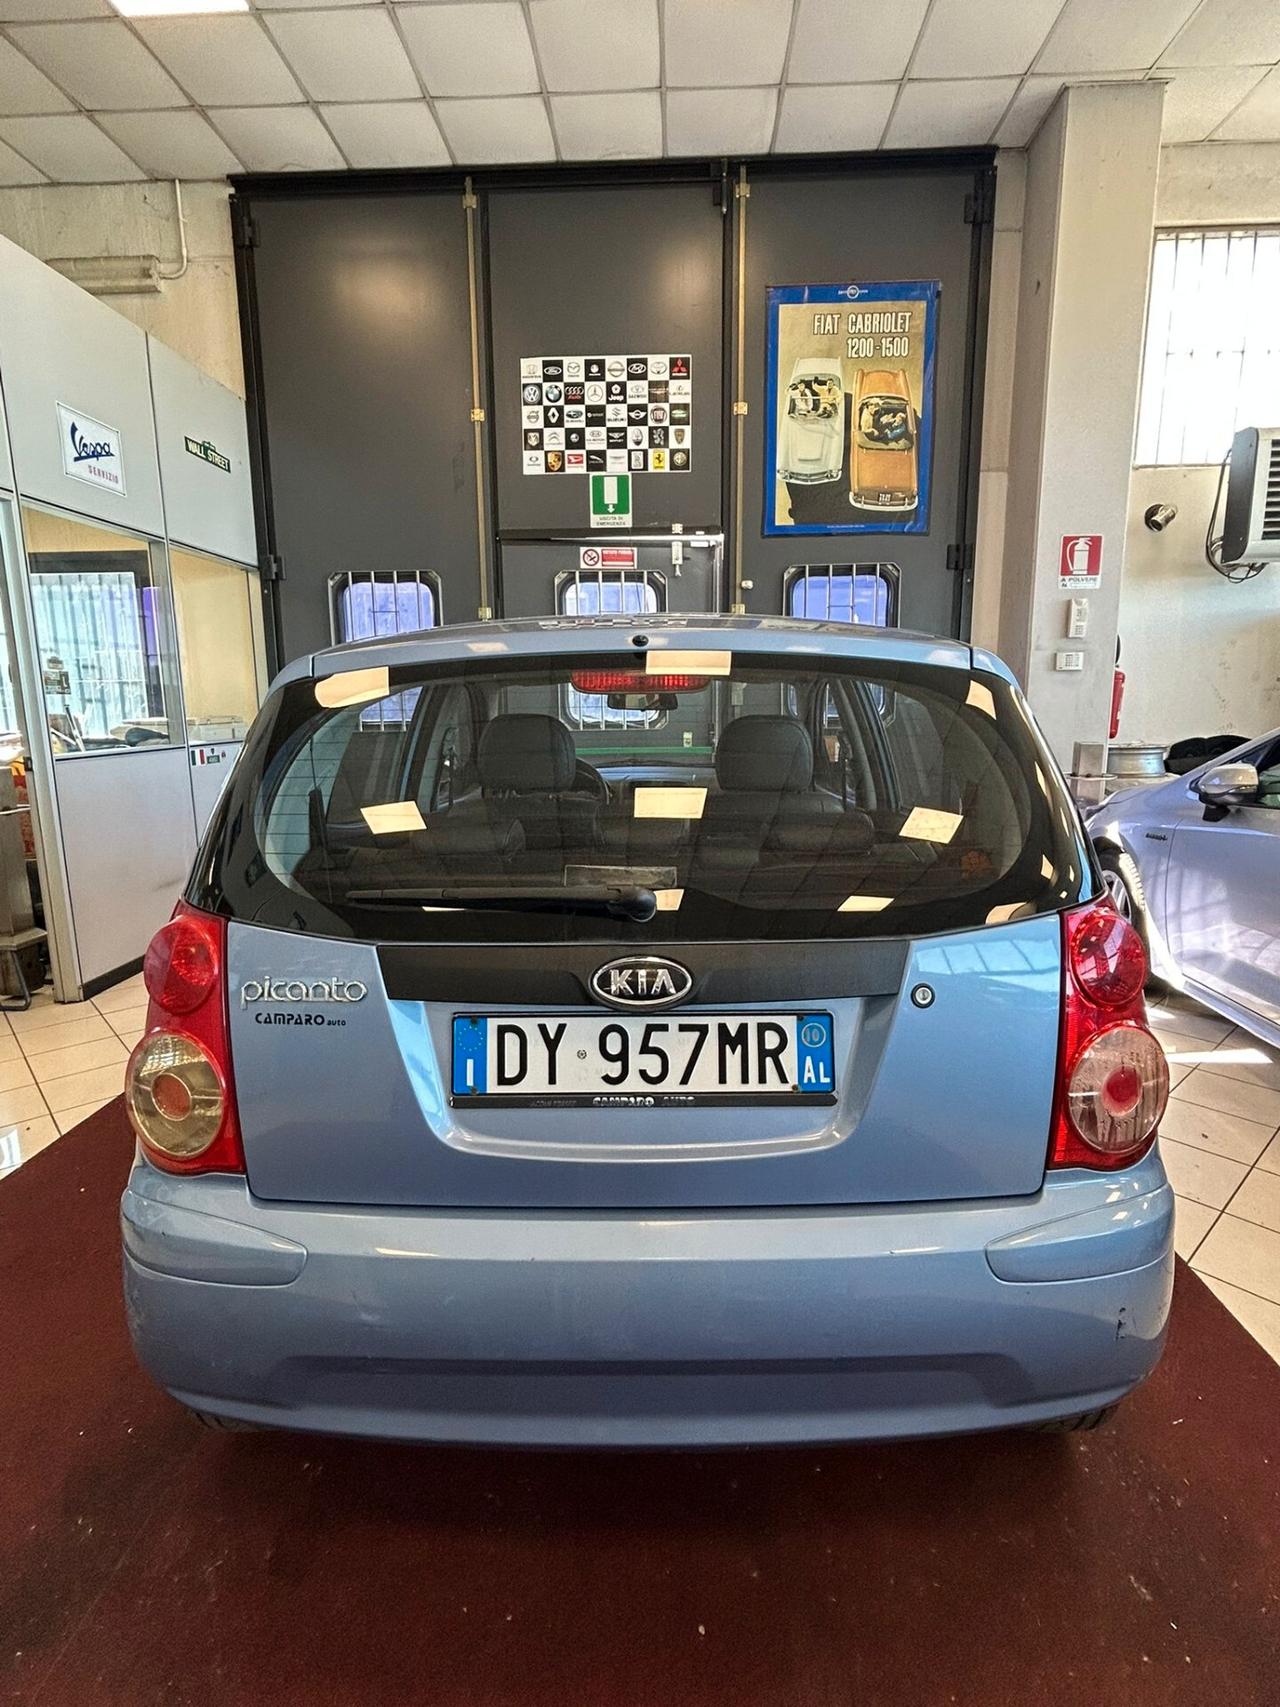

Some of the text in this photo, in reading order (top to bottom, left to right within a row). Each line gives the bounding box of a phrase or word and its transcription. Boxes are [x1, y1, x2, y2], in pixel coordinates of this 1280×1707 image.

[813, 311, 912, 335] FIAT CABRIOLET
[70, 421, 115, 462] Vespa
[186, 439, 230, 470] WALL STREET
[88, 464, 119, 484] SERVIZIO
[240, 976, 367, 1010] picanto
[608, 968, 677, 996] KIA
[255, 1012, 347, 1027] CAMPARO auto
[497, 1023, 567, 1086] DY
[599, 1022, 789, 1086] 957MR
[803, 1055, 831, 1084] AL
